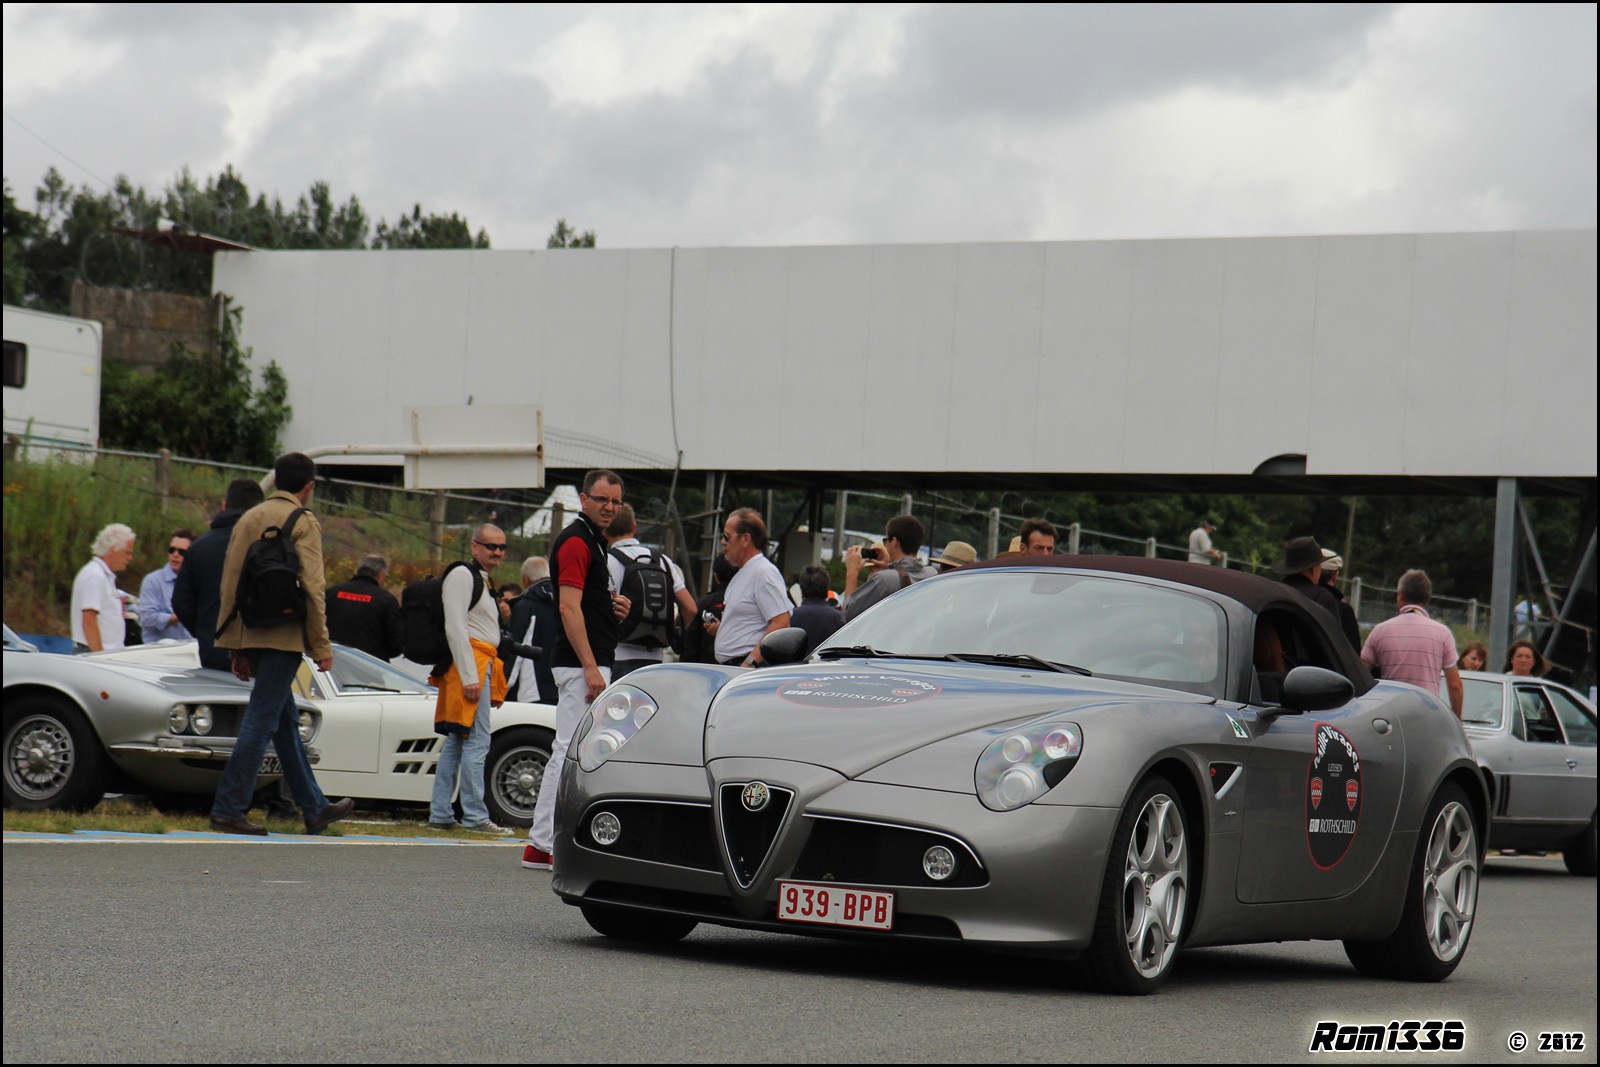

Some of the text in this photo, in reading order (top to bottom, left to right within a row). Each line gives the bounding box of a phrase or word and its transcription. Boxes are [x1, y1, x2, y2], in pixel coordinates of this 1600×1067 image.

[812, 690, 907, 704] ROTHSCHILD
[1313, 725, 1360, 773] Mille Virages
[1319, 818, 1357, 835] ROTHSCHILD
[785, 887, 889, 924] 939-BPB
